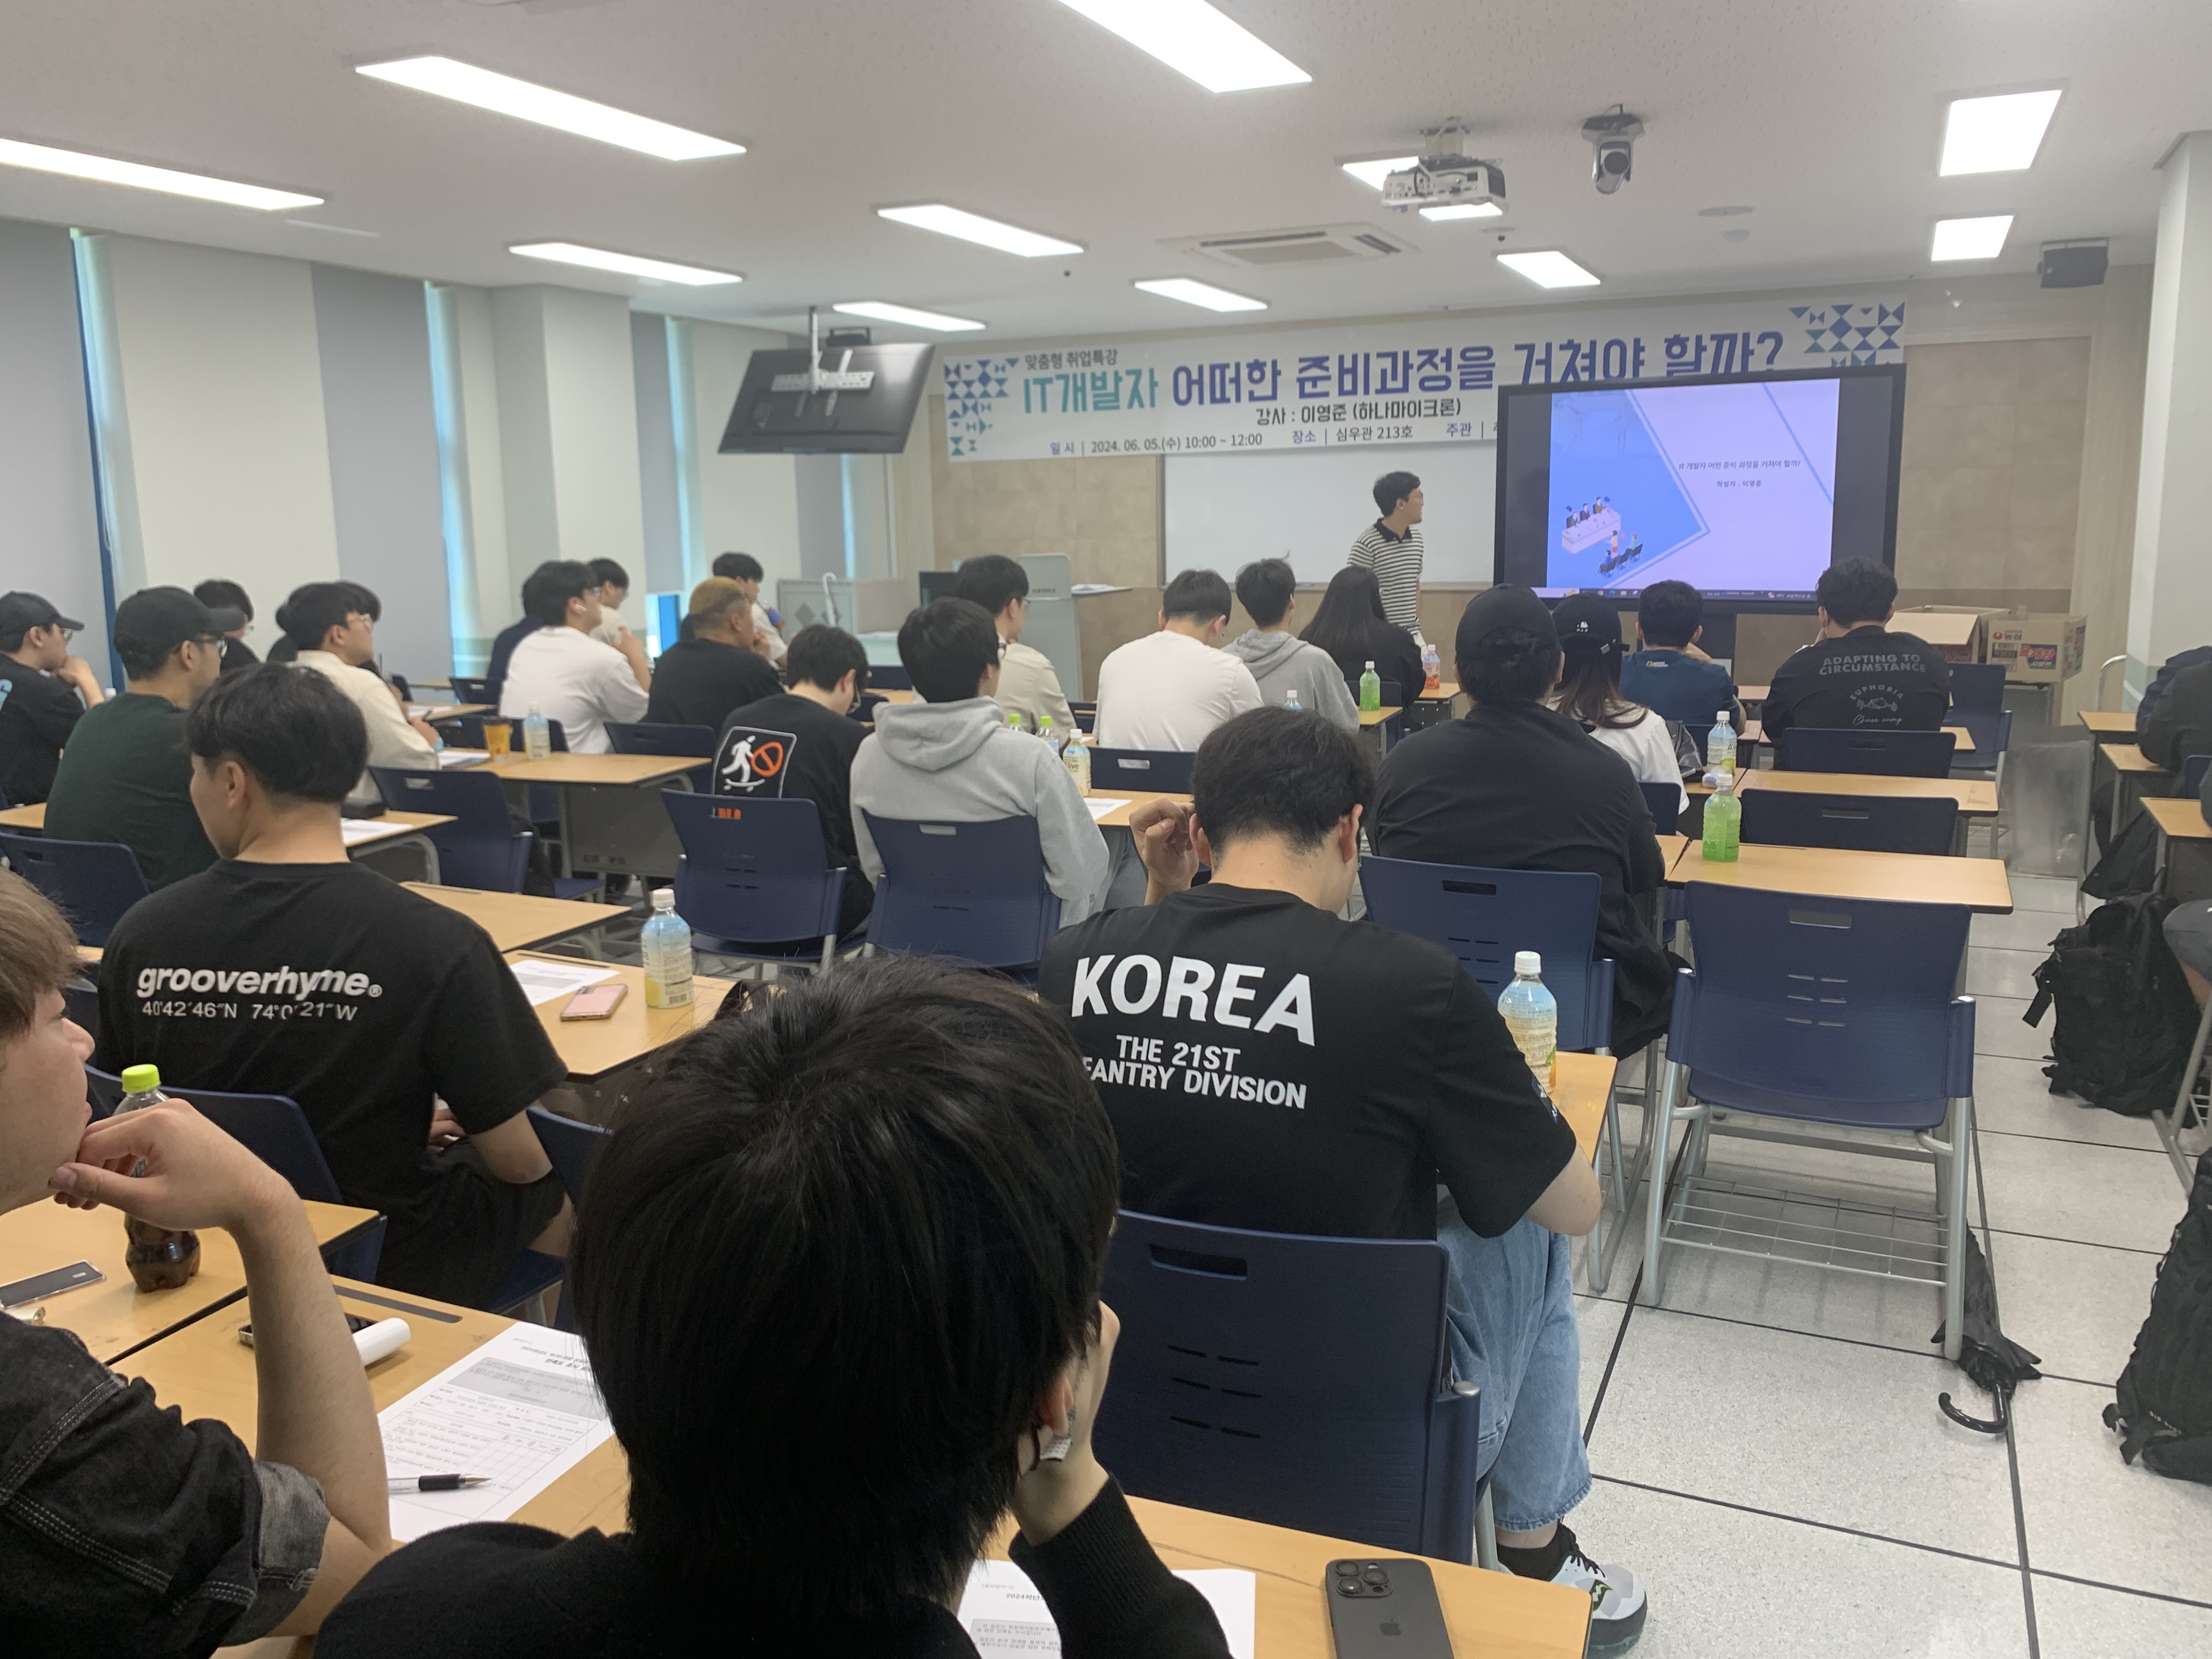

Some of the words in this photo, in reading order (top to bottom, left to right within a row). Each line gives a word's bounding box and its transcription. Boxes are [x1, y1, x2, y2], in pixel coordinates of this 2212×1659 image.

[1024, 352, 1063, 371] 맞춤형
[1066, 348, 1118, 368] 취업특강
[1024, 367, 1159, 414] IT개발자
[1172, 358, 1282, 407] 어떠한
[1296, 345, 1496, 399] 준비과정을
[1514, 337, 1646, 384] 거쳐야
[1664, 331, 1784, 376] 할까?
[1256, 407, 1286, 426] 강사
[1301, 403, 1347, 424] 이영준
[1352, 397, 1462, 421] (하나마이크론)
[1292, 428, 1317, 444] 장소
[1335, 426, 1373, 443] 심우관
[1376, 424, 1414, 440] 213호
[1446, 421, 1472, 438] 주관
[1091, 441, 1121, 453] 2024.
[1123, 439, 1141, 451] 06.
[1185, 435, 1216, 449] 10:00
[1231, 433, 1263, 447] 12:00
[1819, 662, 1926, 676] CIRCUMSTANCE
[1822, 653, 1898, 667] ADAPTING
[1903, 653, 1921, 663] TO
[1849, 684, 1905, 701] EUPHORIA
[1071, 953, 1316, 1047] KOREA
[1116, 1034, 1164, 1063] THE
[1171, 1041, 1241, 1072] 21ST
[1183, 1069, 1307, 1110] DIVISION
